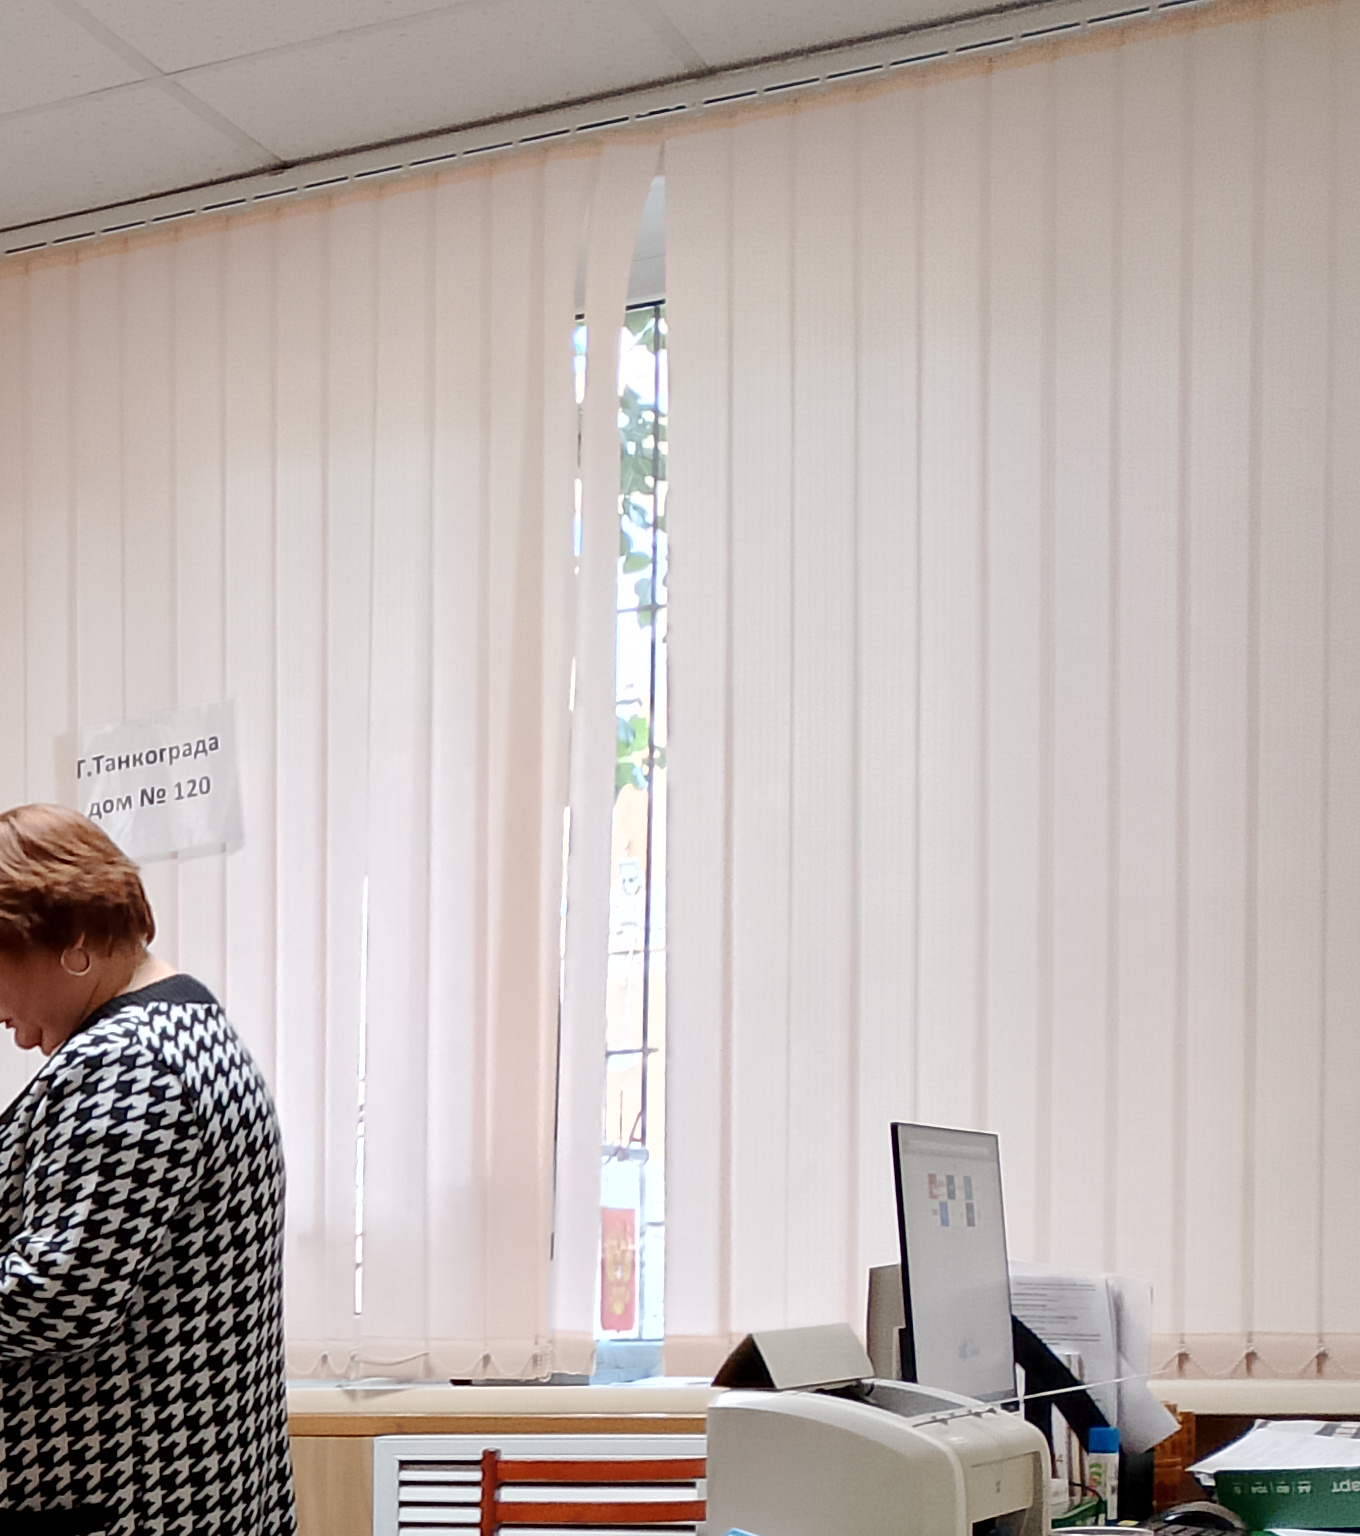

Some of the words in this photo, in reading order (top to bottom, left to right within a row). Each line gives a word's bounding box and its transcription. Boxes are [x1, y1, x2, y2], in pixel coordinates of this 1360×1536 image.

[77, 735, 220, 779] Г.Танкограда
[140, 786, 167, 808] №
[174, 775, 211, 801] 120
